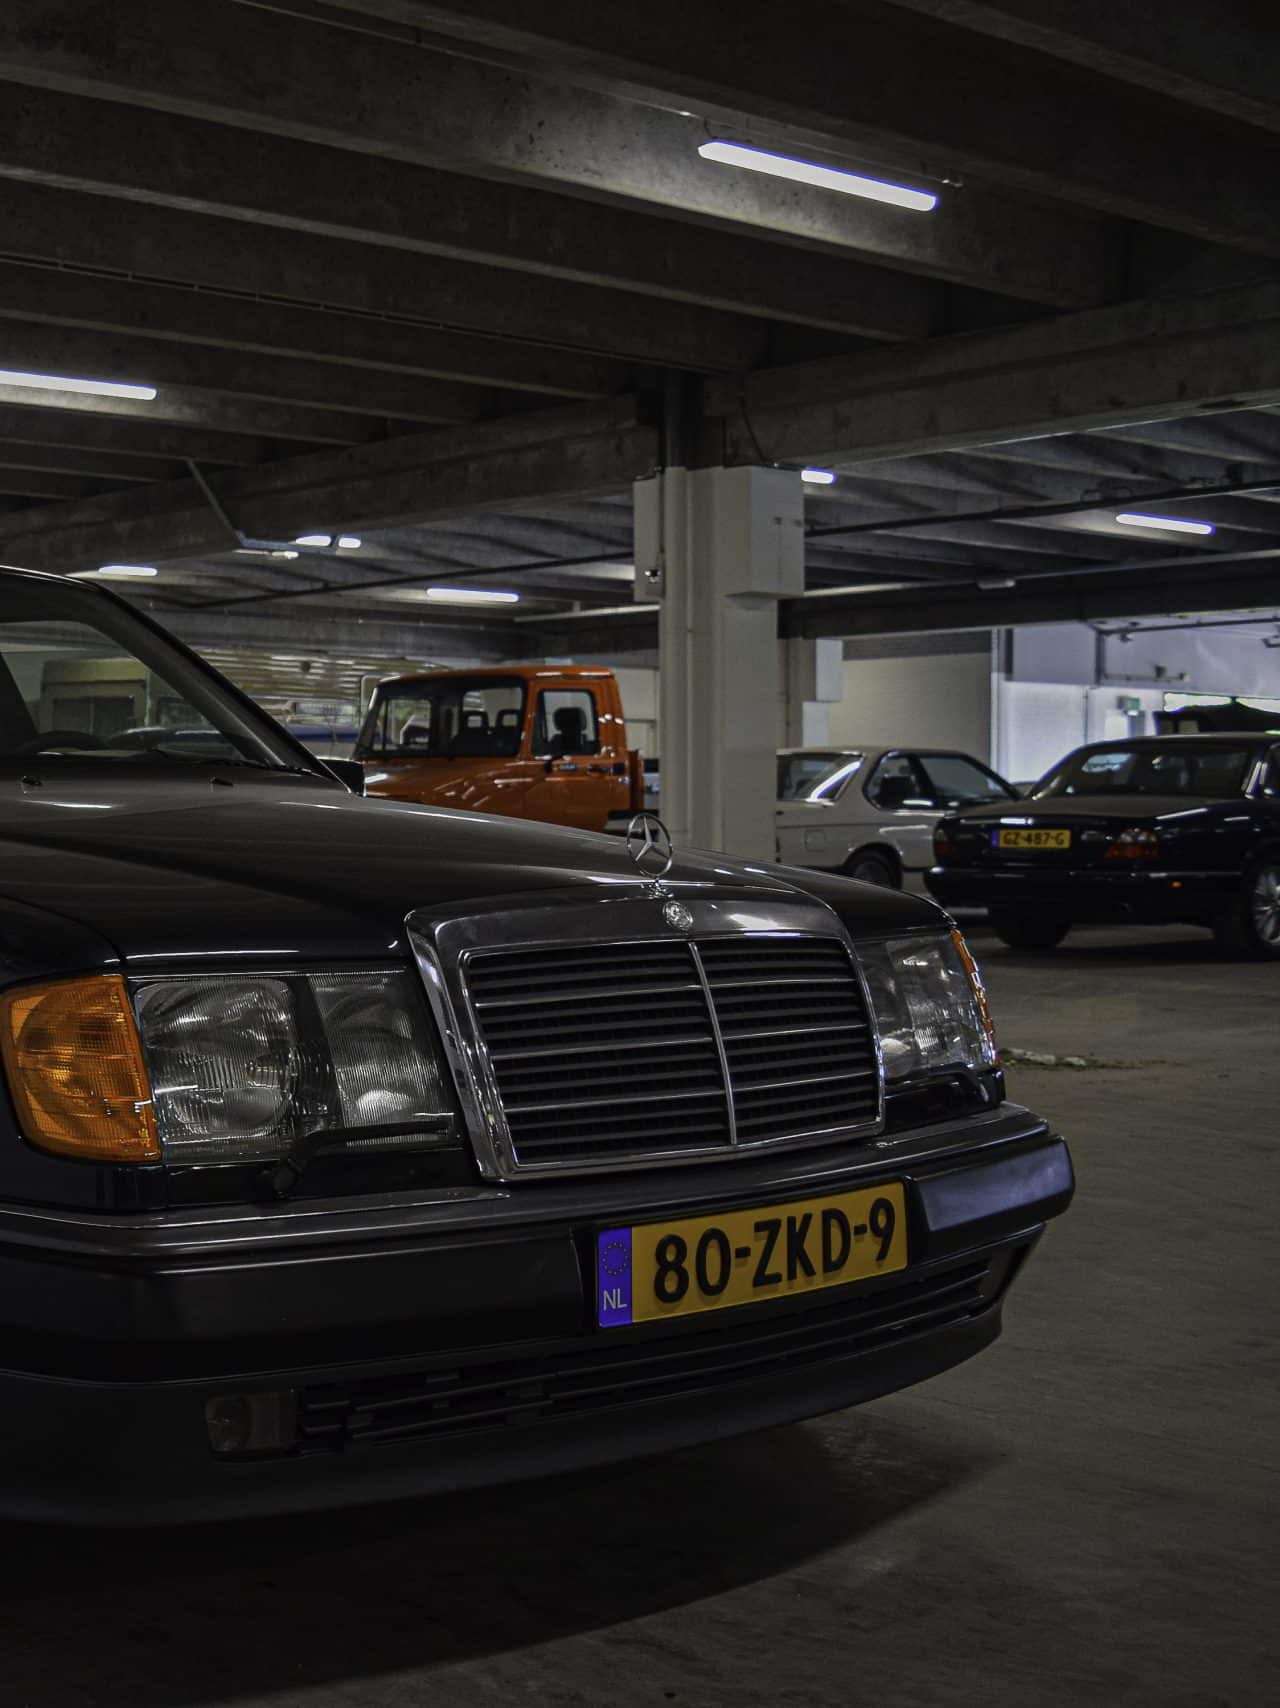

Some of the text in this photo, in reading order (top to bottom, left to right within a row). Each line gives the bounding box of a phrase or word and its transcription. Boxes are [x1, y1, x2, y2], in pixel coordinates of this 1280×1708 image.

[1002, 832, 1065, 846] GZ-487-G
[653, 1198, 896, 1304] 80-ZKD-9
[602, 1287, 628, 1312] NL
